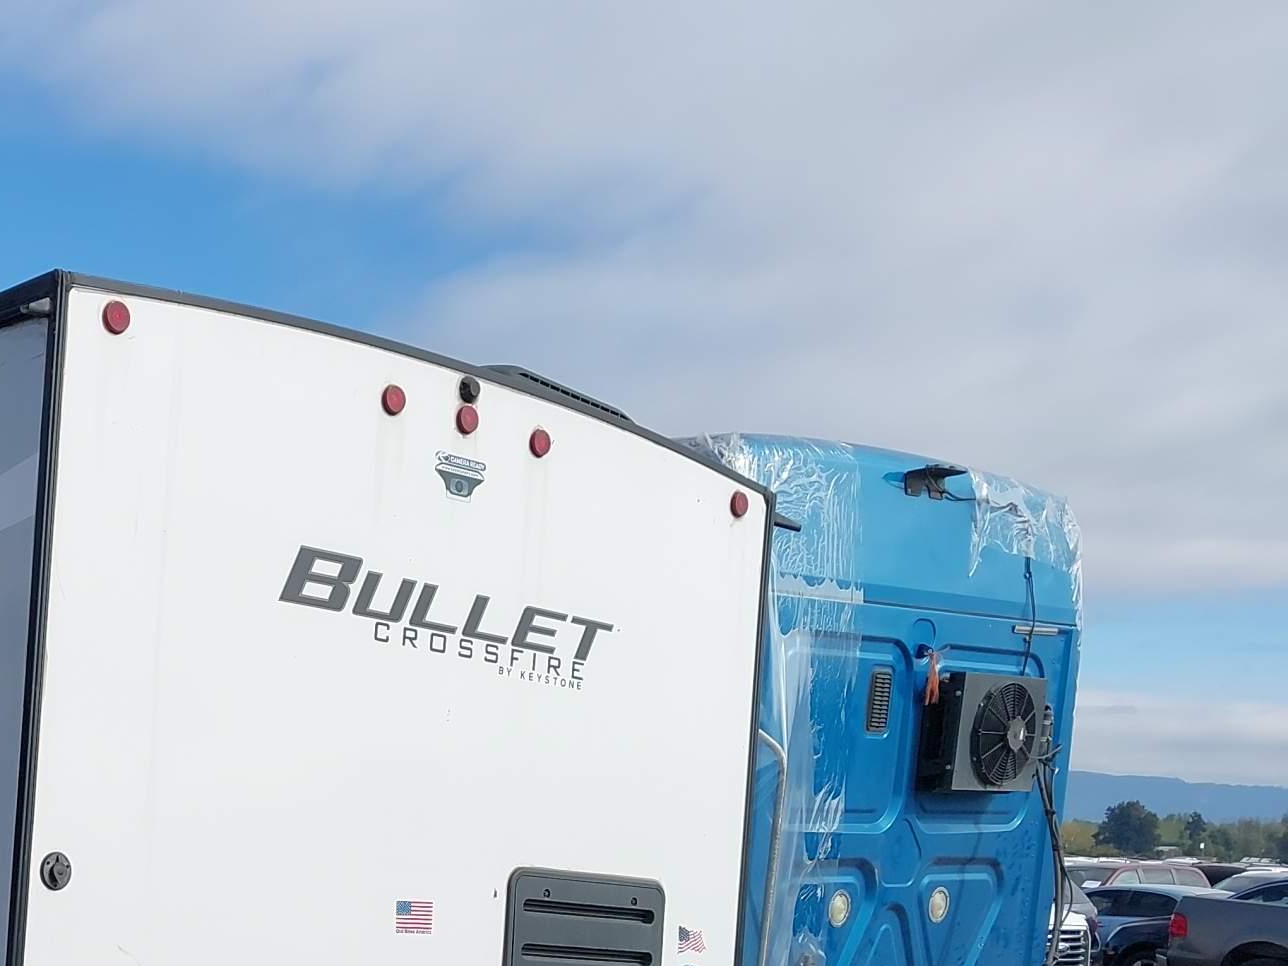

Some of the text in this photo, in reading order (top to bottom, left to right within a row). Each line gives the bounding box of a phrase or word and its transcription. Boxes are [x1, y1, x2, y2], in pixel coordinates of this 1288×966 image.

[279, 545, 614, 661] BULLET
[374, 622, 585, 680] CROSSFIRE
[498, 665, 582, 690] BY KEYSTONE
